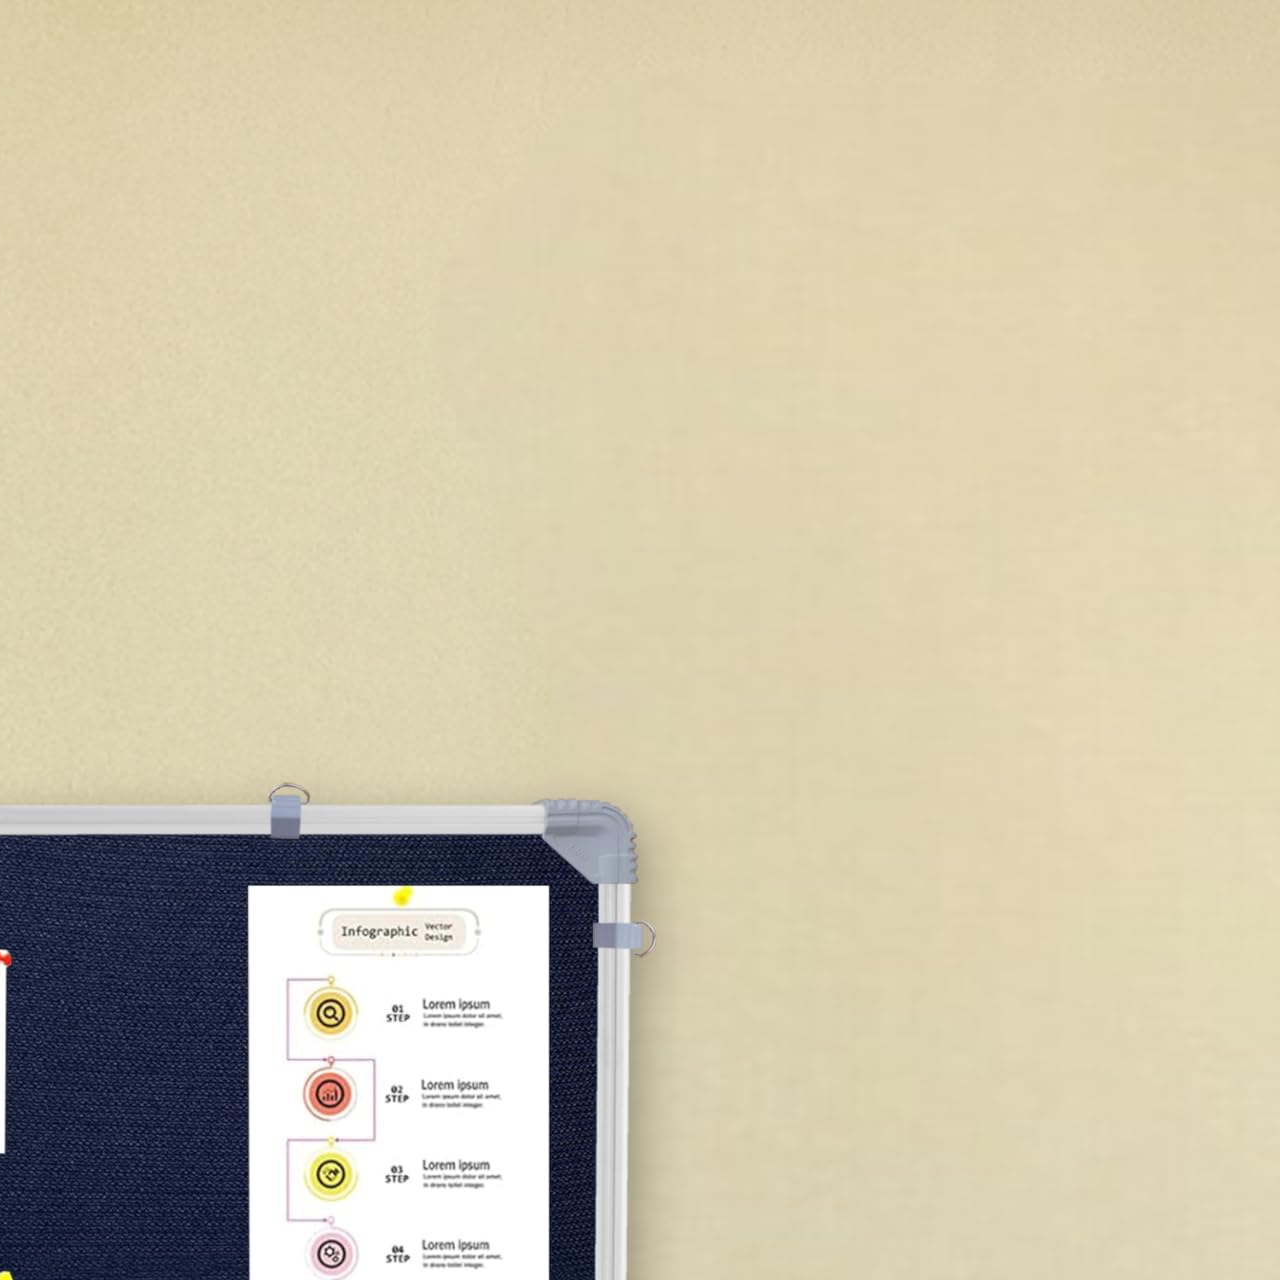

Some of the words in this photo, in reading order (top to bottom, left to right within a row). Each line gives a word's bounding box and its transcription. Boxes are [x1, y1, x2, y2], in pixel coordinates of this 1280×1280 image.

[341, 926, 419, 939] Infographic
[424, 934, 453, 942] Design
[391, 1005, 404, 1013] 01
[422, 999, 456, 1010] Lorem
[458, 999, 491, 1011] ipsum
[385, 1013, 410, 1022] STEP
[390, 1086, 404, 1094] 02
[421, 1080, 455, 1090] Lorem
[457, 1080, 489, 1092] ipsum
[385, 1095, 410, 1103] STEP
[390, 1166, 404, 1174] 03
[422, 1160, 456, 1170] Lorem
[458, 1160, 491, 1172] ipsum
[385, 1175, 410, 1183] STEP
[421, 1240, 456, 1250] Lorem
[458, 1240, 490, 1252] ipsum
[385, 1253, 410, 1263] STEP
